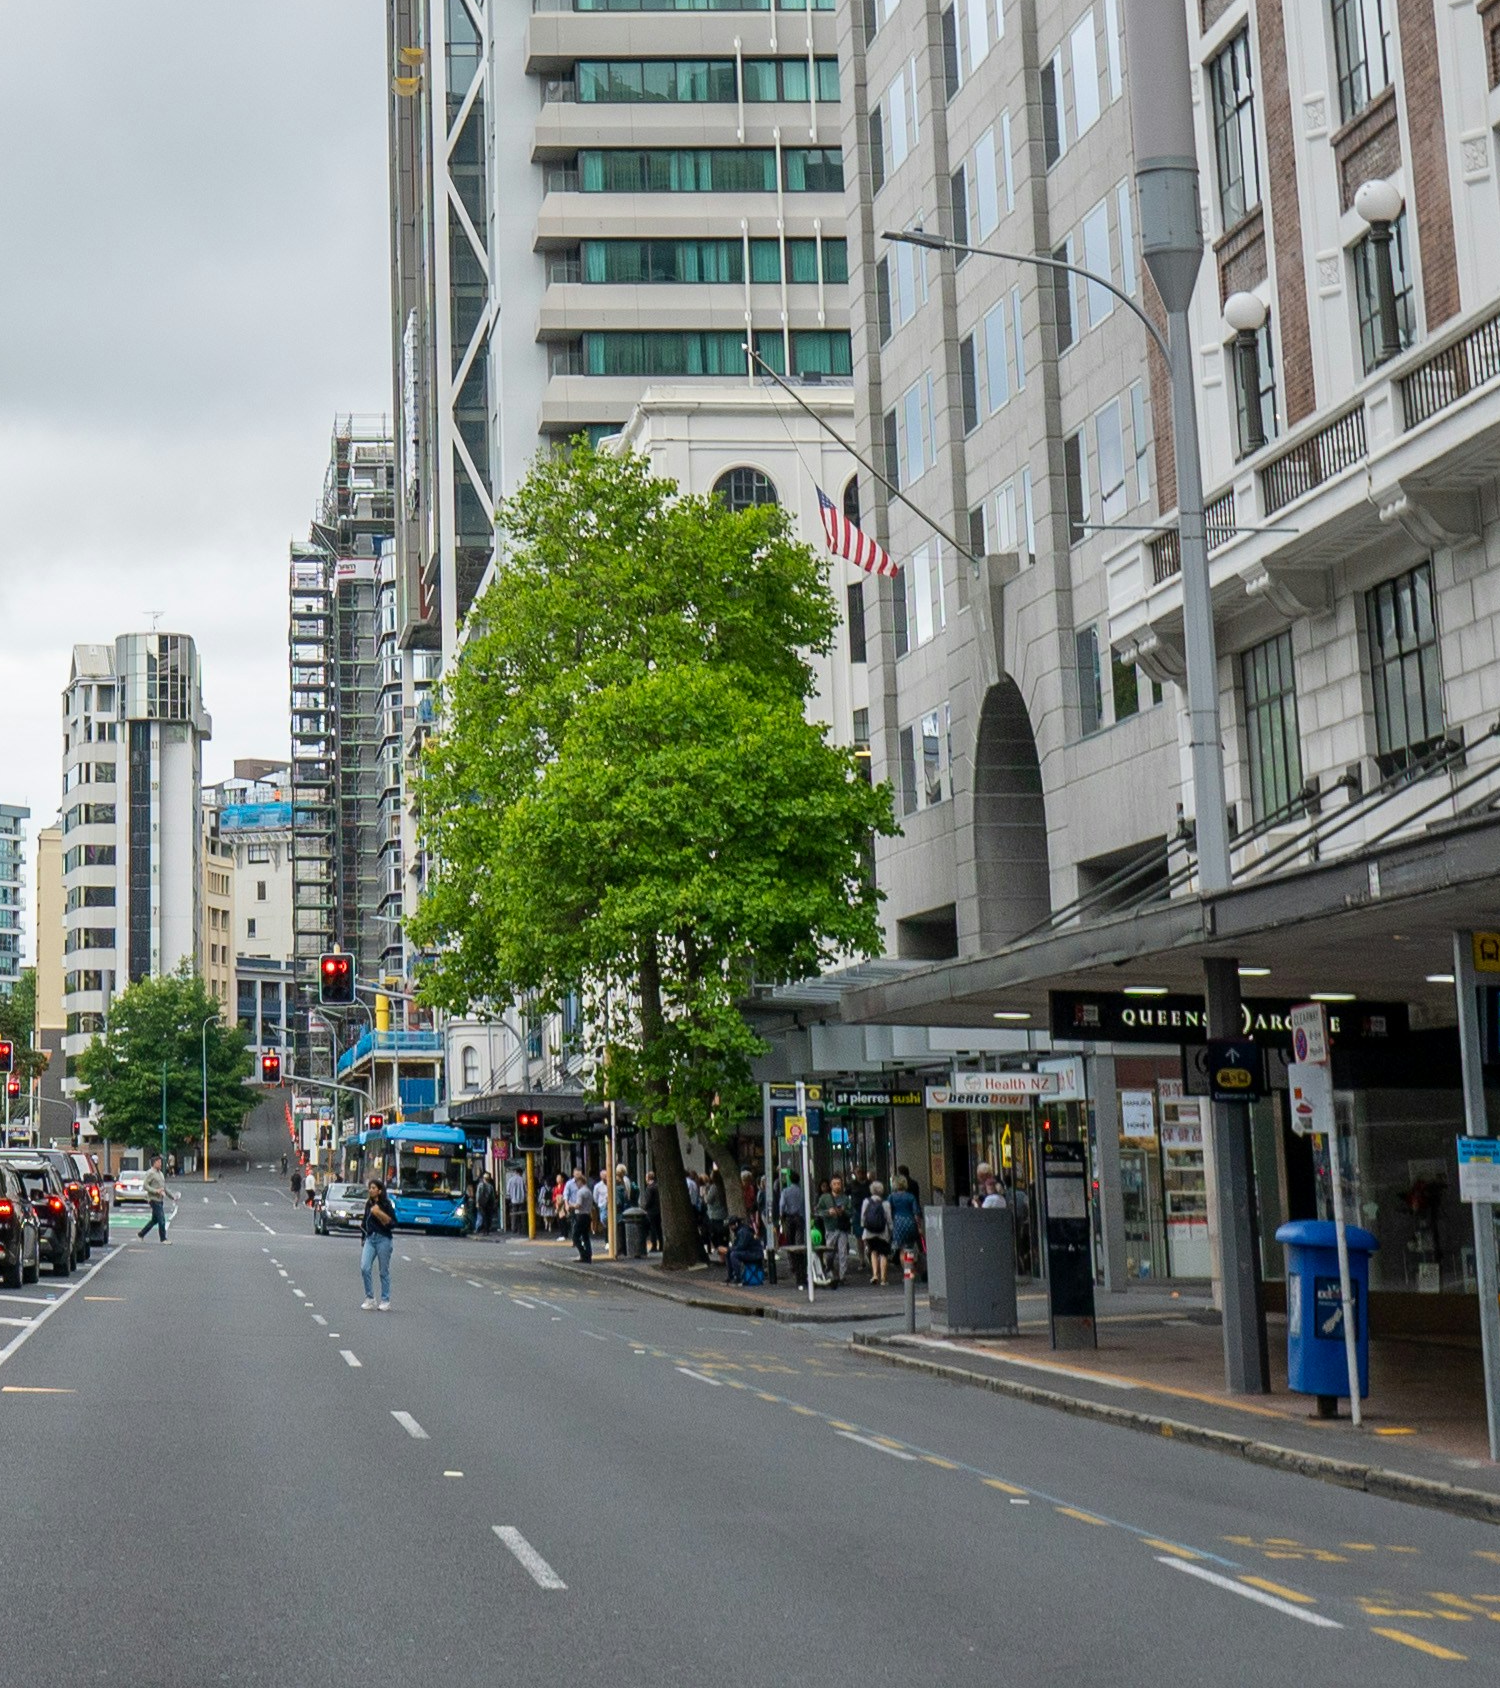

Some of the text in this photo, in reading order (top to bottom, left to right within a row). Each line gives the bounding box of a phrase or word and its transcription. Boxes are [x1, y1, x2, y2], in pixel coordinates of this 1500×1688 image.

[1254, 1014, 1341, 1032] ARCE
[985, 1078, 1026, 1090] Health
[1031, 1078, 1049, 1089] NZ
[837, 1091, 921, 1105] st pierres sushi
